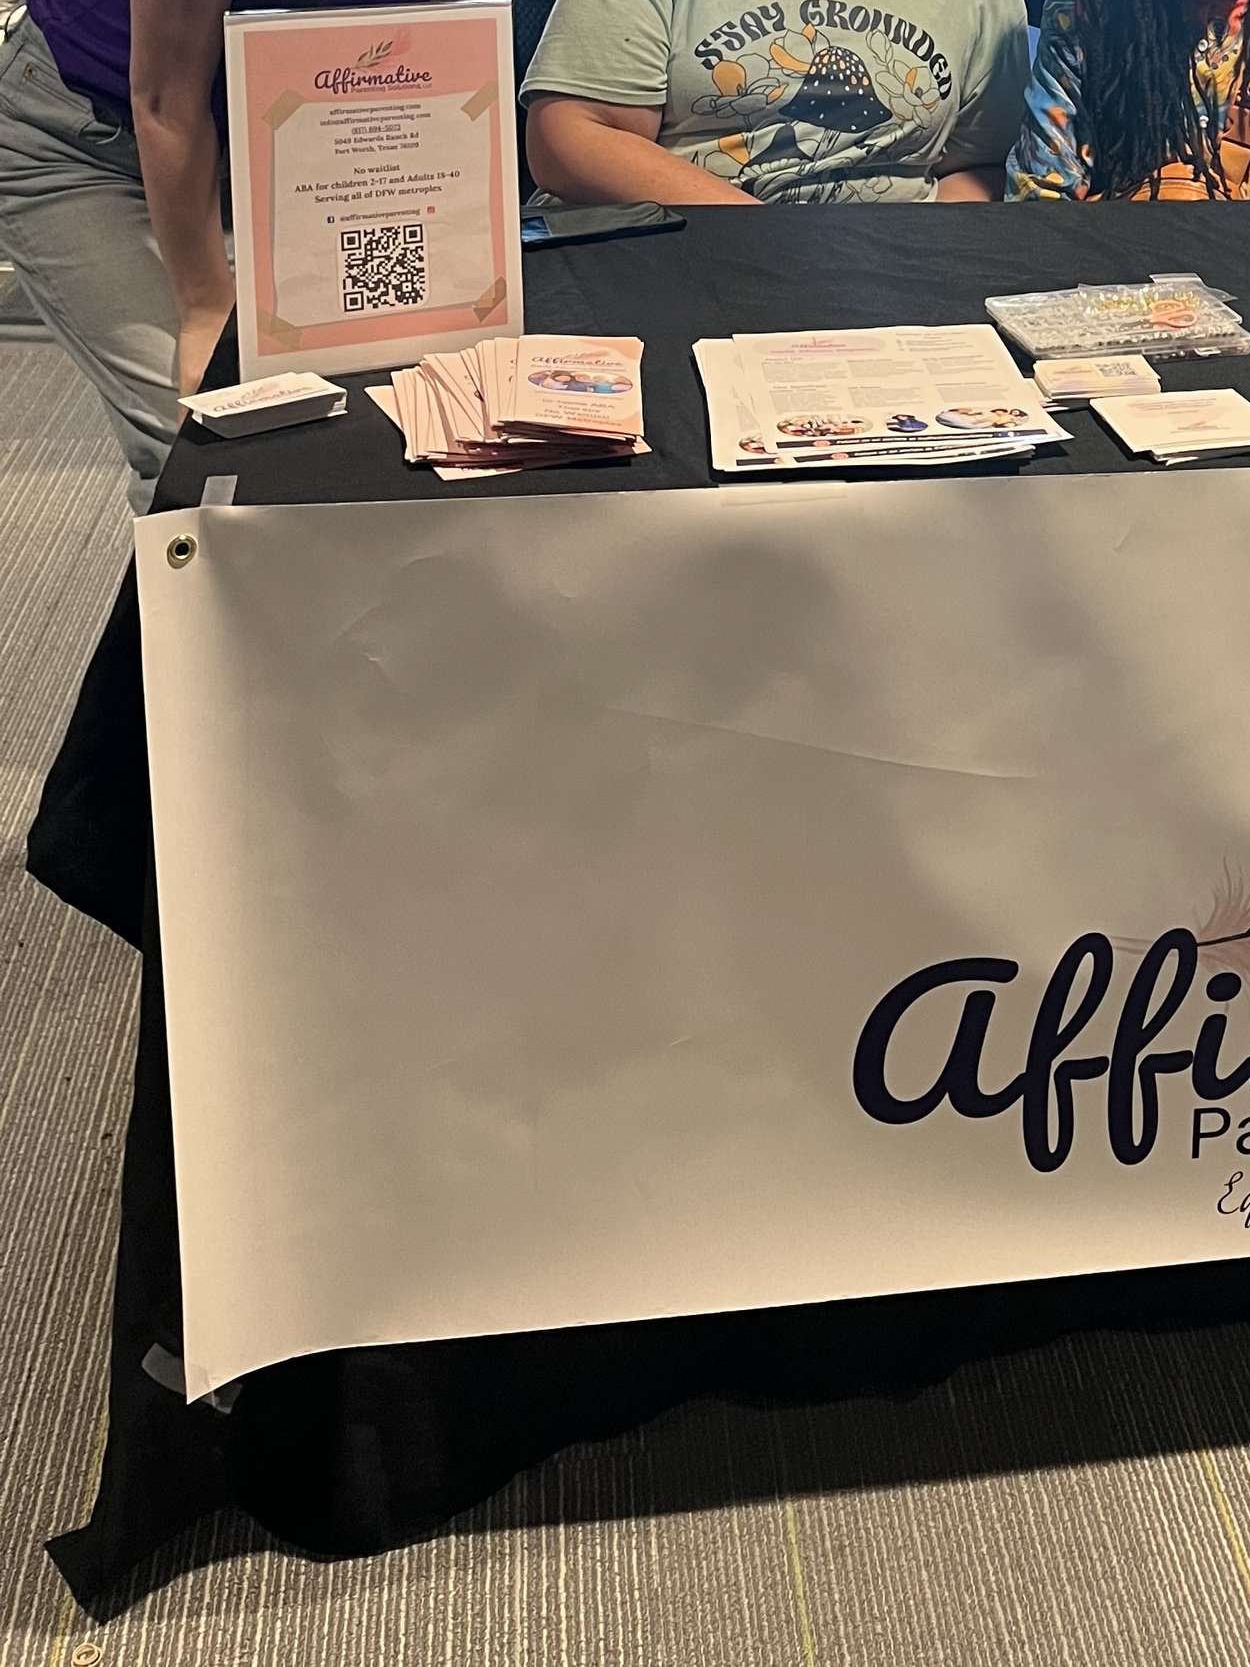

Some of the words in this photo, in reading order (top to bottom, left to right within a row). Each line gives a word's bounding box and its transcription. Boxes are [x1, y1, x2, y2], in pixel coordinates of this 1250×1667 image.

[694, 1, 787, 71] STAY
[314, 65, 433, 94] Affirmative
[351, 85, 386, 94] Parenting
[353, 134, 385, 144] Edwards
[385, 133, 408, 142] Ranch
[335, 146, 350, 155] Fort
[354, 166, 366, 175] No
[367, 163, 400, 175] waitlist
[295, 184, 313, 194] ABA
[315, 182, 330, 192] for
[331, 178, 368, 190] children
[369, 177, 388, 186] 2-17
[389, 175, 405, 184] and
[407, 173, 435, 183] Adults
[436, 170, 460, 180] 18-40
[314, 192, 350, 204] Serving
[351, 191, 362, 201] all
[364, 189, 375, 199] of
[375, 188, 396, 198] DFW
[398, 184, 443, 196] metroplex
